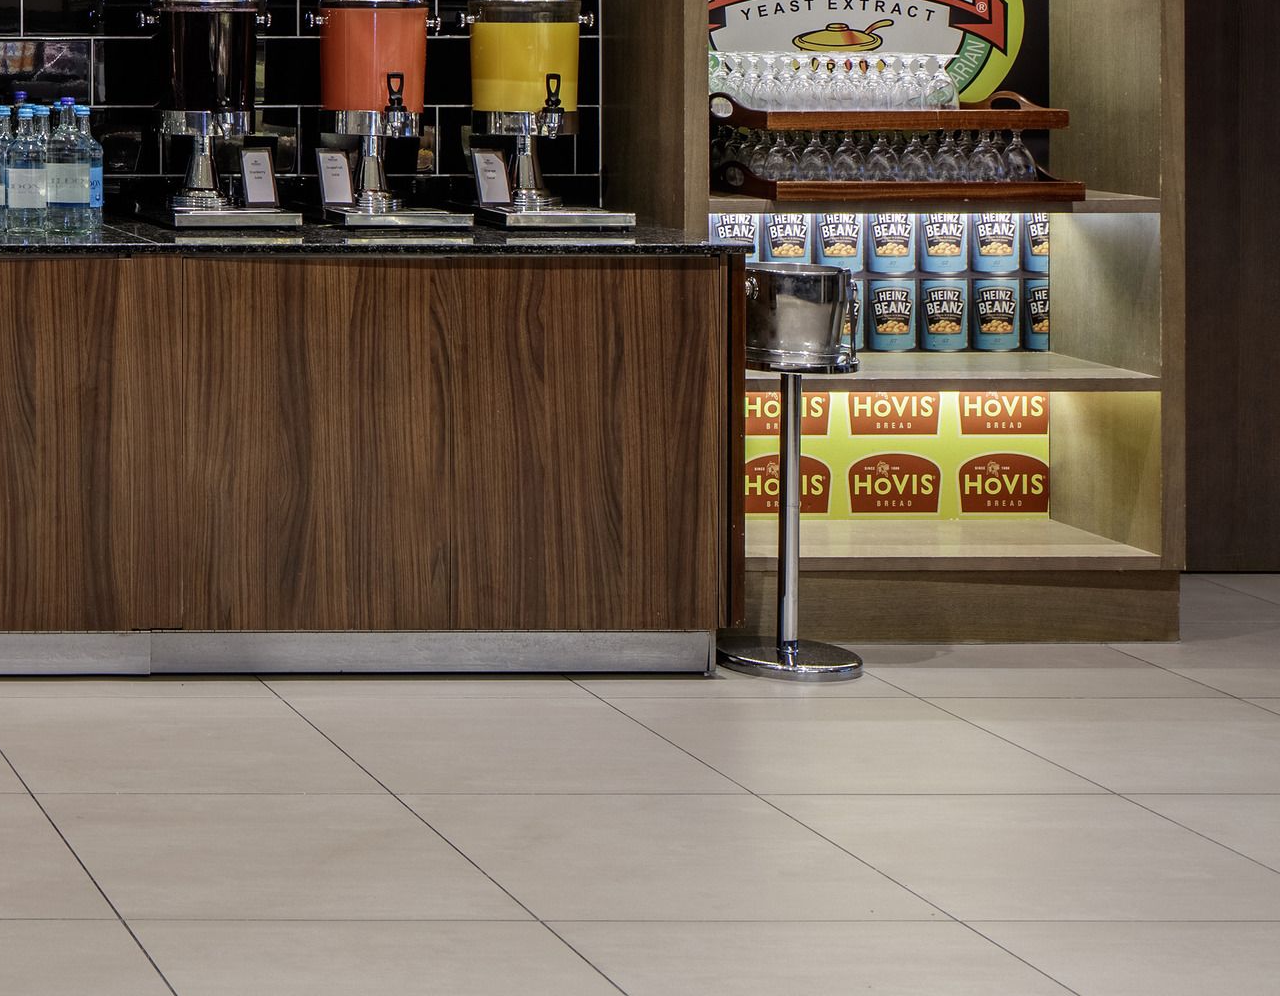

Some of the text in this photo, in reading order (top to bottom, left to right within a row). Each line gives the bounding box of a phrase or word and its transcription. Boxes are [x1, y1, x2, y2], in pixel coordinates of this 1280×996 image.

[878, 290, 908, 302] HEINZ
[982, 290, 1010, 301] HEINZ
[874, 302, 913, 315] BEANZ
[978, 301, 1016, 315] BEANZ
